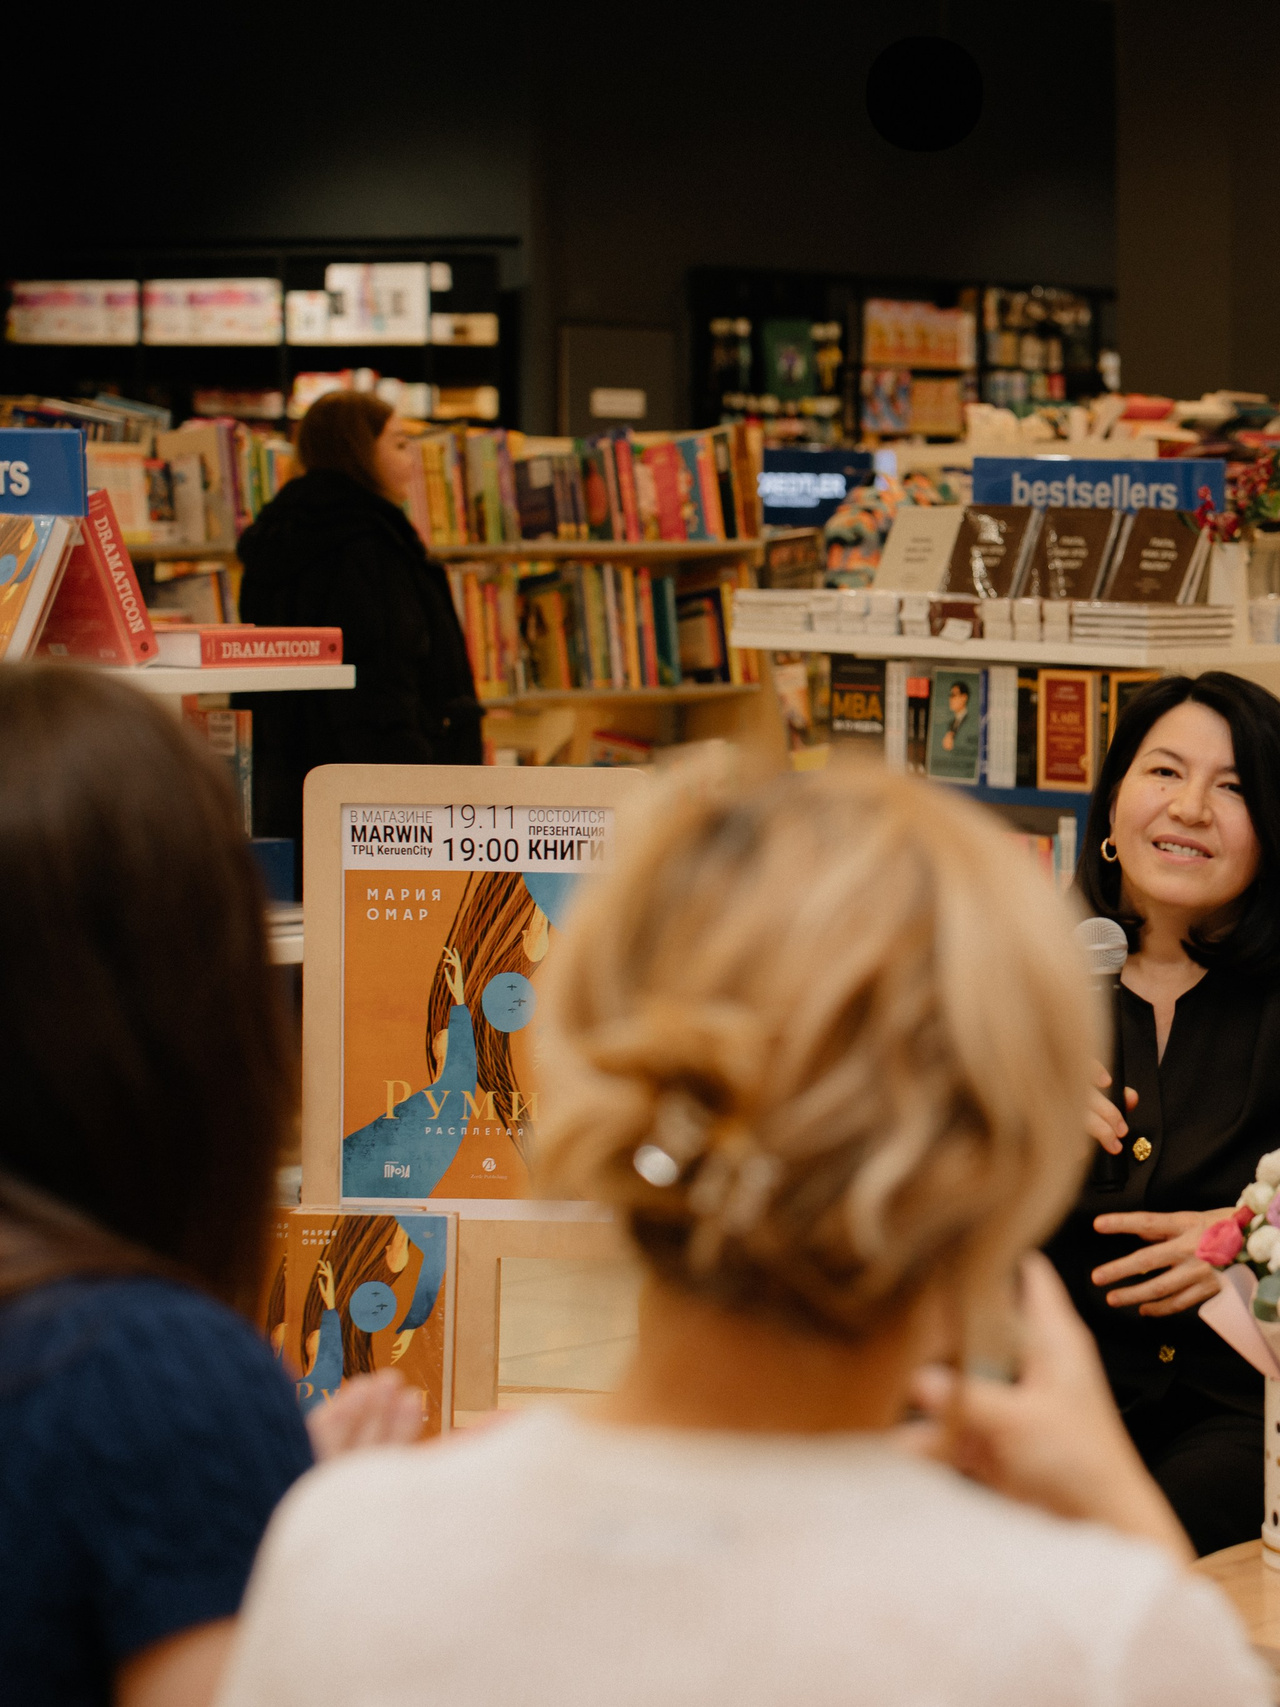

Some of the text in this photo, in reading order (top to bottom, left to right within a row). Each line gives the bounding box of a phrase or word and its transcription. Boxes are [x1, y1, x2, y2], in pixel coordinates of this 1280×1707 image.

[1011, 471, 1178, 510] bestsellers
[94, 515, 146, 634] DRAMATICON
[221, 640, 321, 659] DRAMATICON
[350, 810, 432, 824] В МАГАЗИНЕ
[444, 804, 514, 829] 19.11
[528, 809, 605, 823] СОСТОИТСЯ
[351, 825, 433, 843] MARWIN
[528, 826, 605, 838] ПРЕЗЕНТАЦИЯ
[352, 845, 433, 858] ТРЦ KeruenCity
[442, 838, 519, 862] 19:00
[367, 888, 442, 901] МАРИЯ
[367, 908, 428, 921] ОМАР
[382, 1080, 542, 1121] РУМИ
[425, 1127, 524, 1136] РАСПЛЕТАЯ
